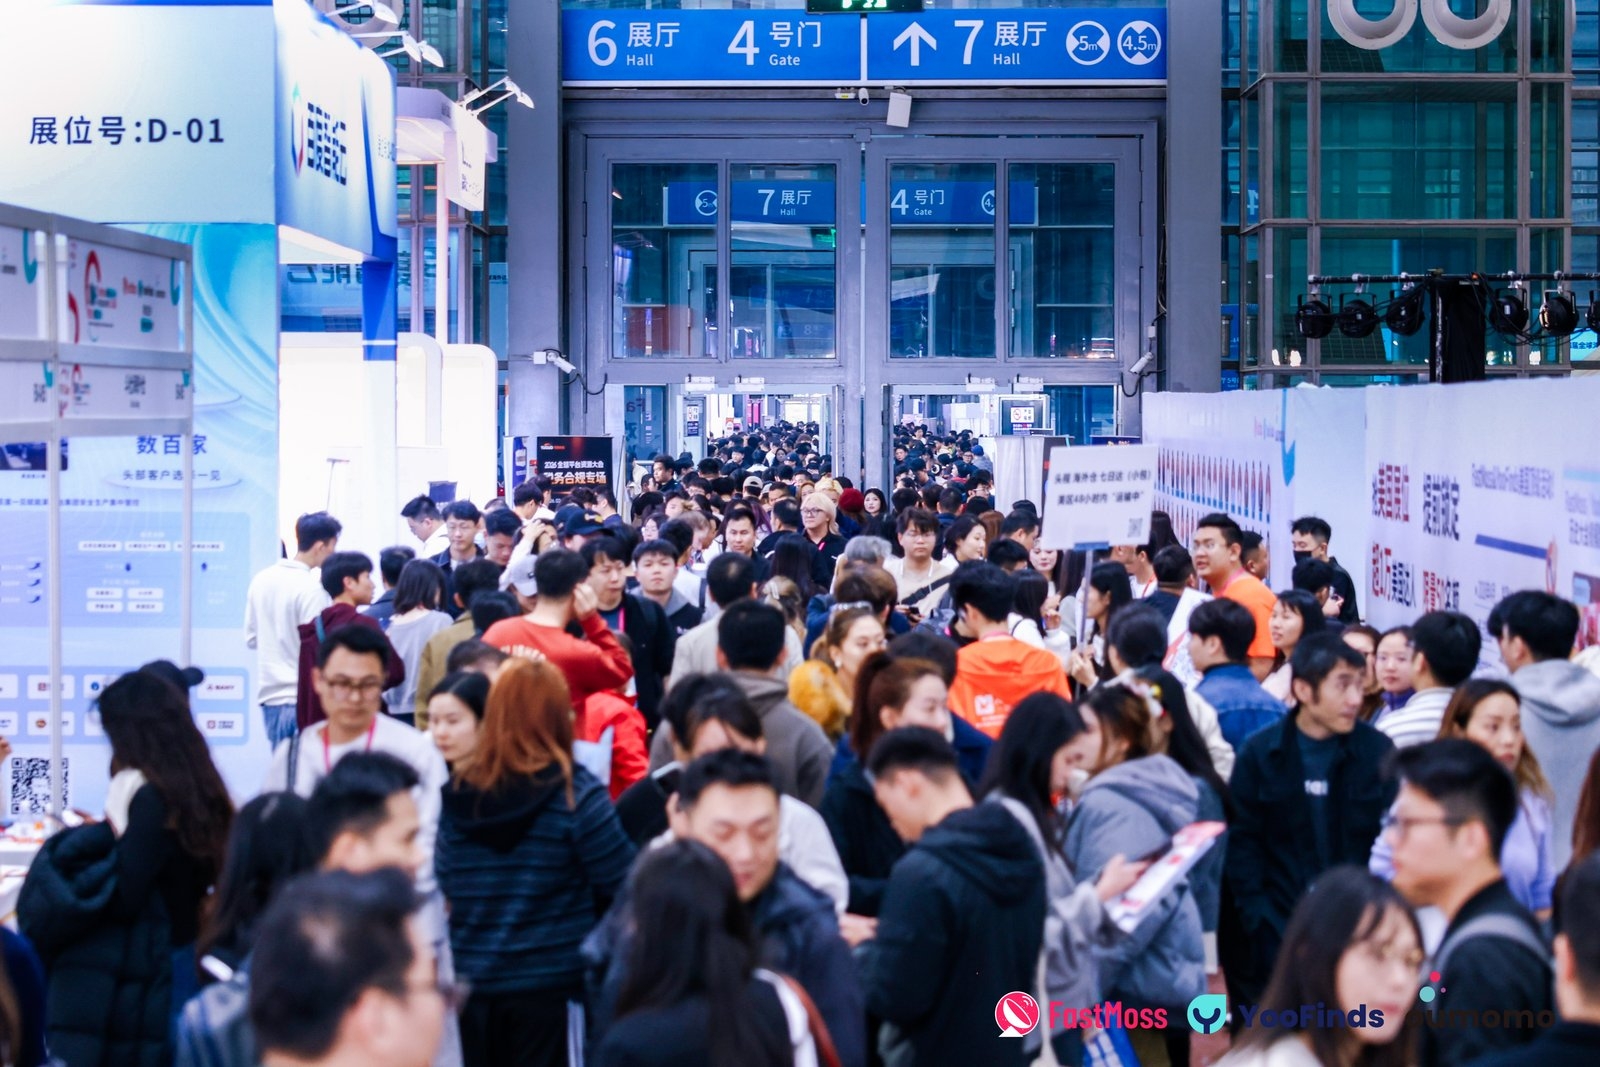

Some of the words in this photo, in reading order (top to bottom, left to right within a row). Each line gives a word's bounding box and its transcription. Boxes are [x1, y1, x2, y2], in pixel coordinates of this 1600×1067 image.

[588, 20, 617, 66] 6
[627, 22, 680, 47] 展厅
[727, 20, 760, 66] 4
[769, 21, 822, 47] 号门
[954, 20, 984, 65] 7
[994, 21, 1047, 46] 展厅
[1079, 35, 1098, 51] 5m
[1122, 35, 1157, 51] 4.5m
[626, 54, 653, 66] Hall
[769, 54, 801, 66] Gate
[993, 53, 1020, 65] Hall
[757, 189, 775, 216] 7
[780, 190, 812, 205] 展厅
[890, 189, 909, 215] 4
[914, 190, 945, 205] 号门
[780, 208, 796, 216] Hall
[914, 208, 933, 216] Gate
[123, 470, 221, 481] 头部客户选一见
